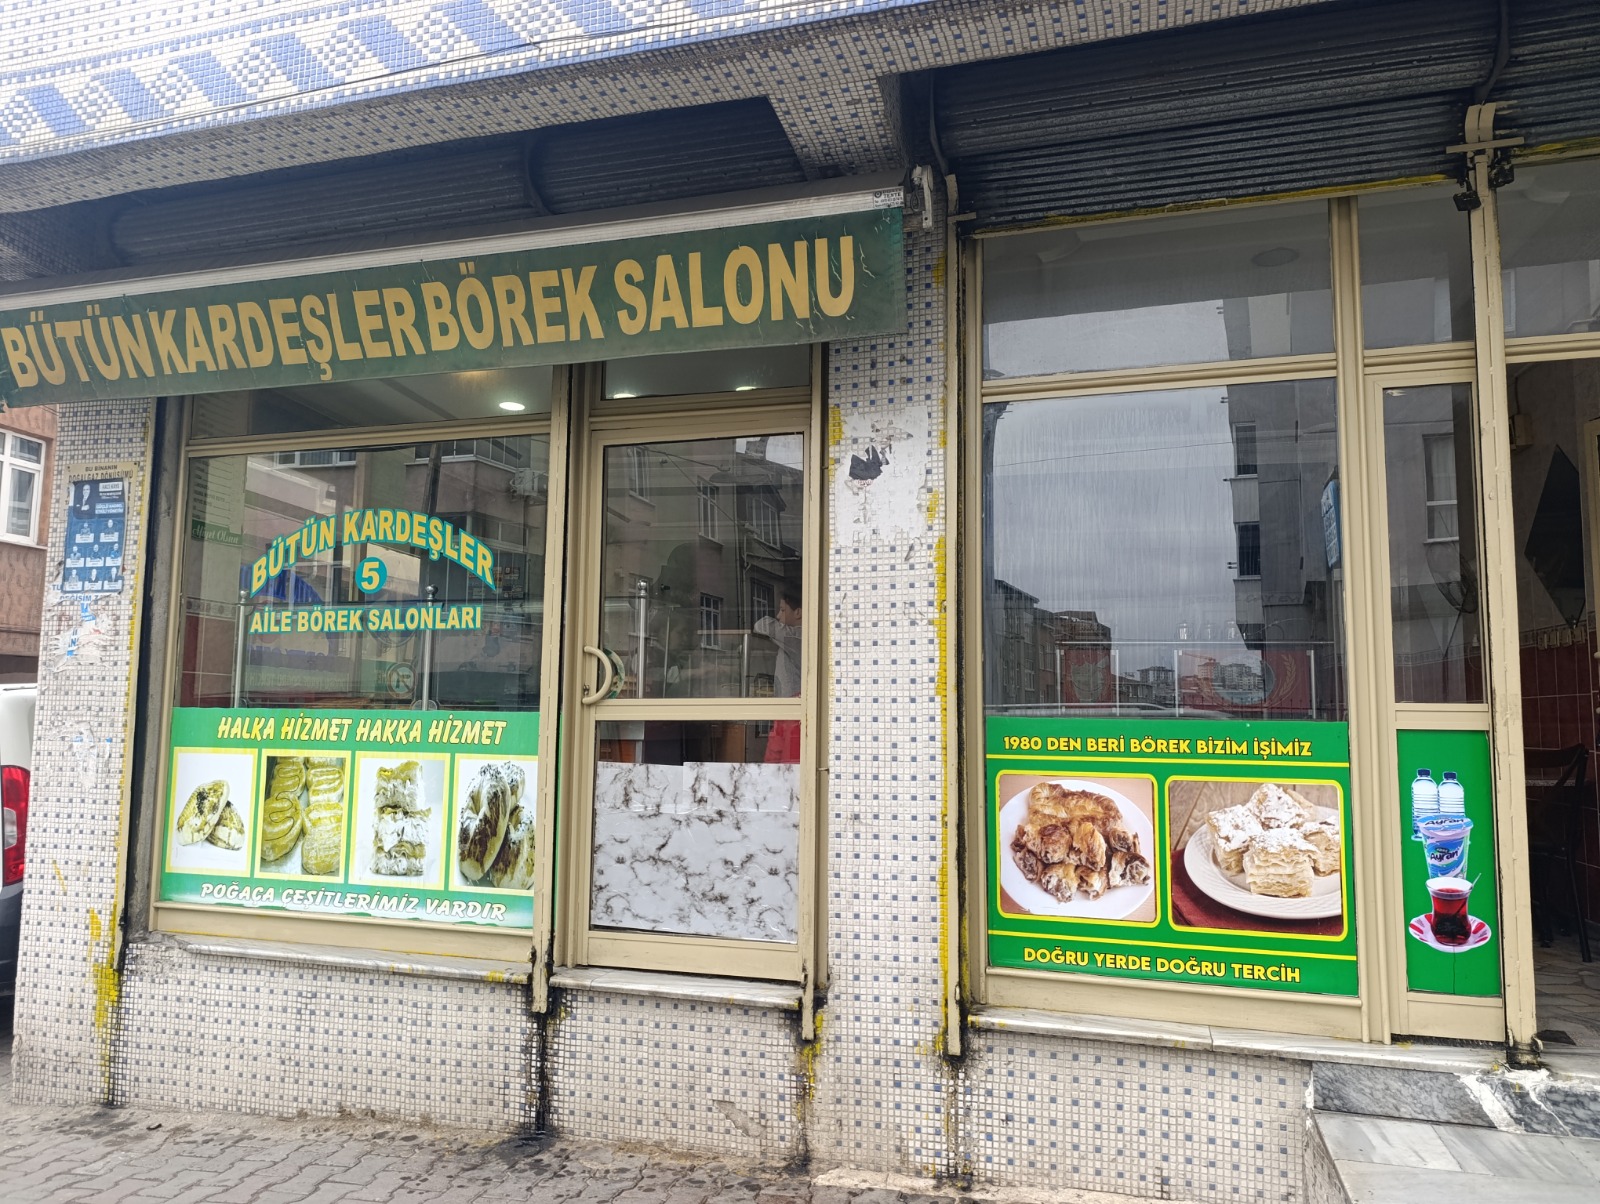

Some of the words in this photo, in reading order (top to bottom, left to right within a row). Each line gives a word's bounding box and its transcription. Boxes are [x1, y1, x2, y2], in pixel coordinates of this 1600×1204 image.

[1, 304, 156, 388] BÜTÜN
[148, 287, 427, 381] KARDEŞLER
[421, 261, 604, 351] BÖREK
[613, 235, 855, 336] SALONU
[251, 516, 336, 598] BÜTÜN
[343, 509, 497, 591] KARDEŞLER
[360, 561, 381, 591] 5
[251, 608, 292, 633] AİLE
[297, 606, 363, 633] BÖREK
[368, 605, 483, 631] SALONLARI
[217, 716, 275, 742] HALKA
[281, 712, 353, 742] HİZMET
[355, 718, 422, 745] HAKKA
[427, 714, 507, 745] HİZMET
[1003, 735, 1043, 751] 1980
[1046, 736, 1082, 751] DEN
[1086, 735, 1126, 753] BERİ
[1129, 735, 1192, 754] BÖREK
[1196, 736, 1249, 756] BİZİM
[1252, 738, 1313, 760] İŞİMİZ
[1430, 851, 1458, 862] Ayran
[201, 881, 276, 905] POĞAÇA
[281, 886, 419, 914] ÇEŞİTLERİMİZ
[425, 898, 507, 921] VARDIR
[1023, 946, 1090, 967] DOĞRU
[1093, 951, 1152, 972] YERDE
[1155, 956, 1227, 978] DOĞRU
[1230, 962, 1301, 984] TERCİH
